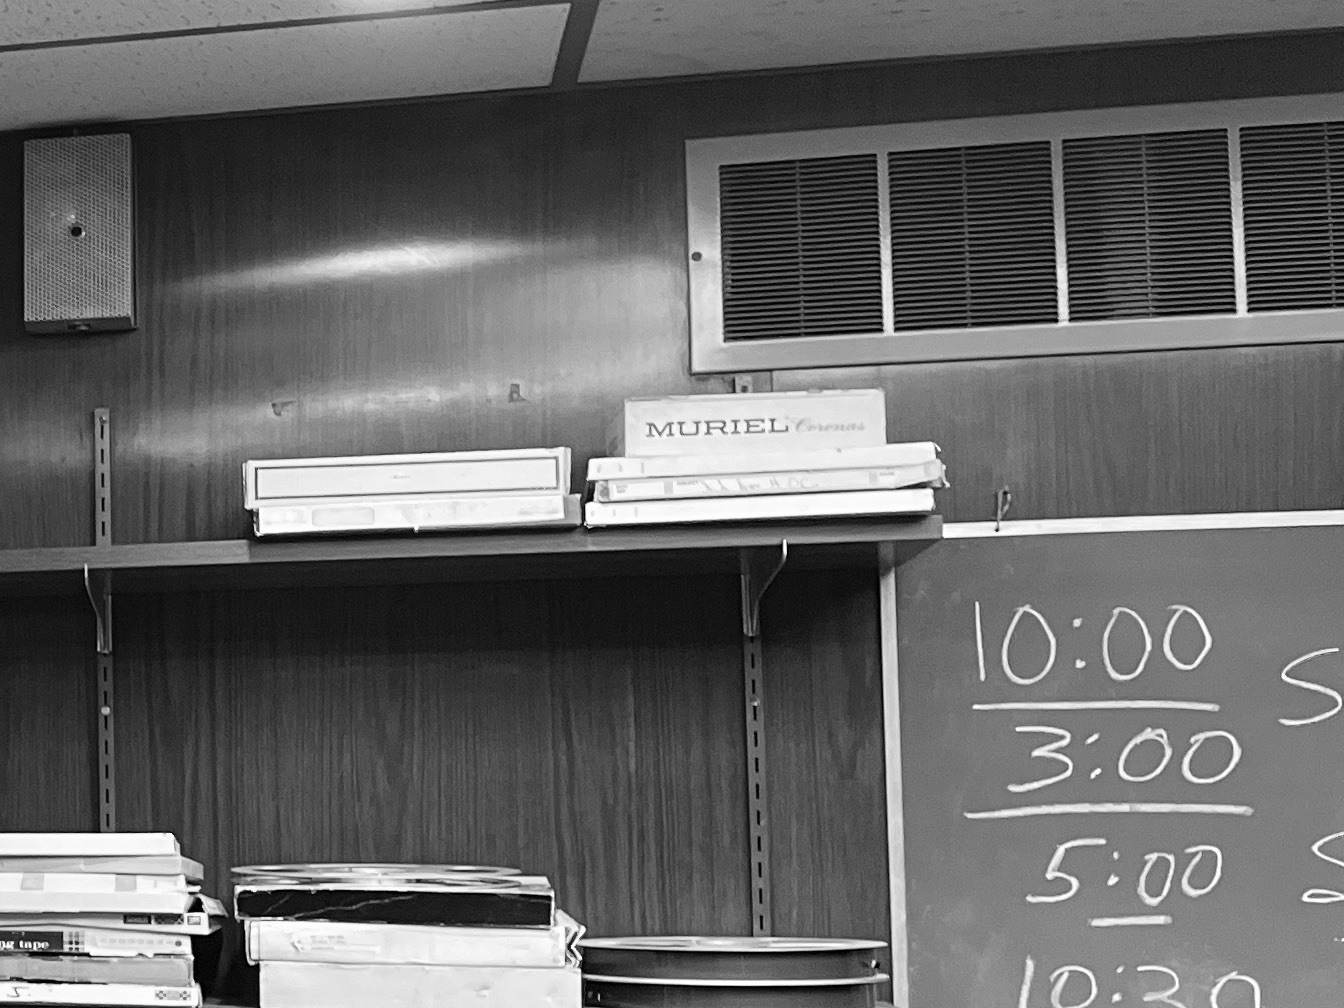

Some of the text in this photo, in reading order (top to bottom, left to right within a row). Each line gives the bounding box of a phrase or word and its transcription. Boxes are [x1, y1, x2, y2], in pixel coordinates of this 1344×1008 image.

[645, 417, 790, 439] MURIEL
[974, 600, 1212, 685] 10:00
[1007, 725, 1242, 793] 3:00
[1025, 837, 1223, 906] 5:00
[19, 938, 50, 951] tape
